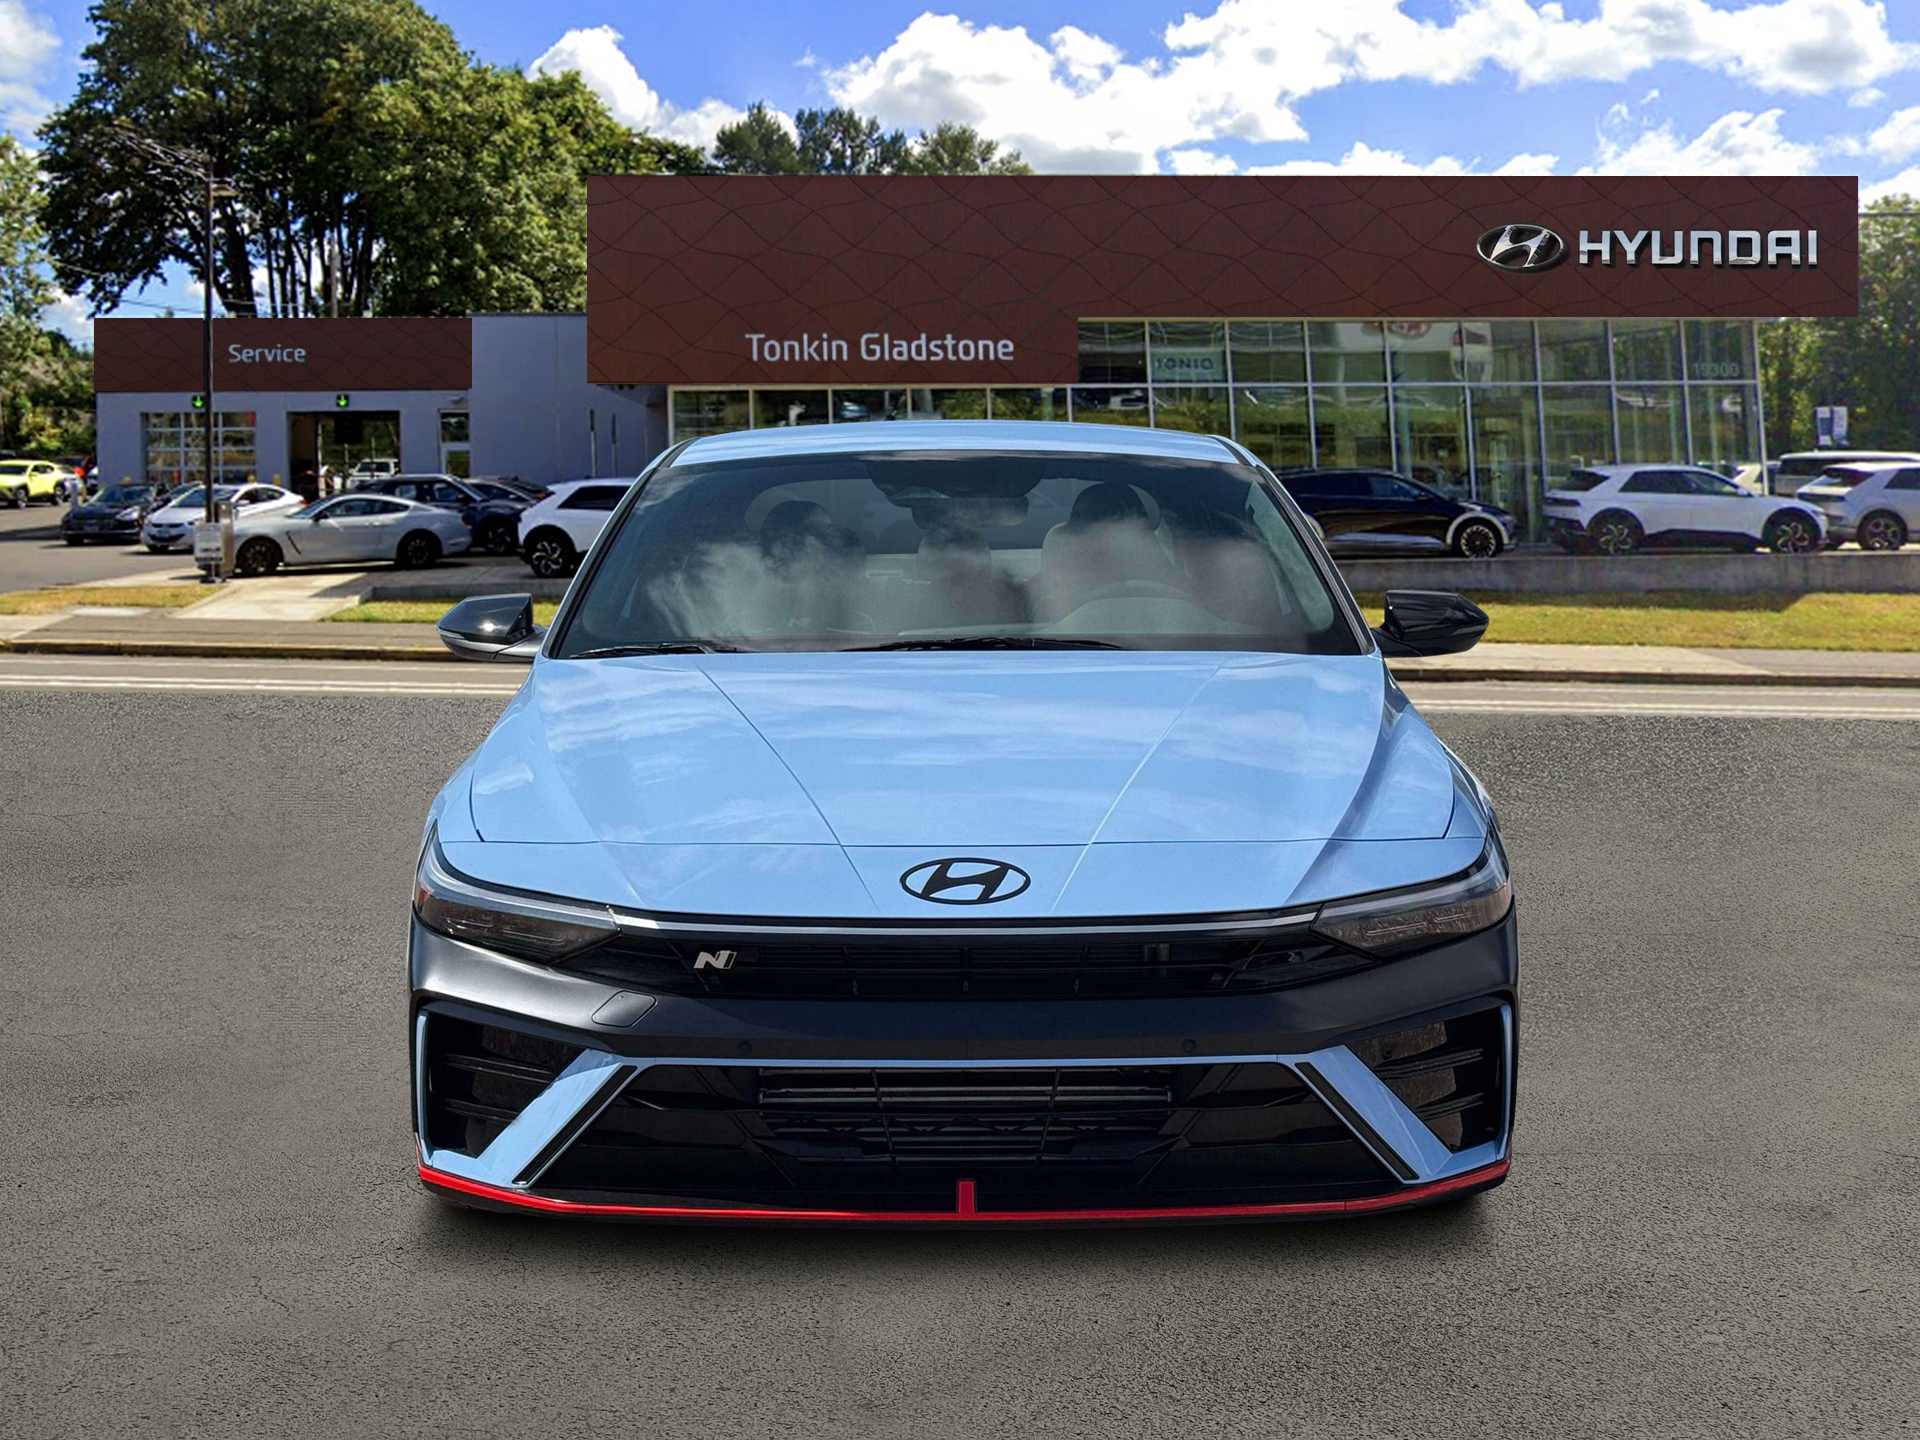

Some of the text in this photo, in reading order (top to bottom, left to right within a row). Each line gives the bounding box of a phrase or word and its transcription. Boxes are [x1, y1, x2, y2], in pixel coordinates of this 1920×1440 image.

[1579, 230, 1817, 265] HYUNDAI
[227, 343, 307, 363] Service
[744, 332, 1015, 362] Tonkin Gladstone
